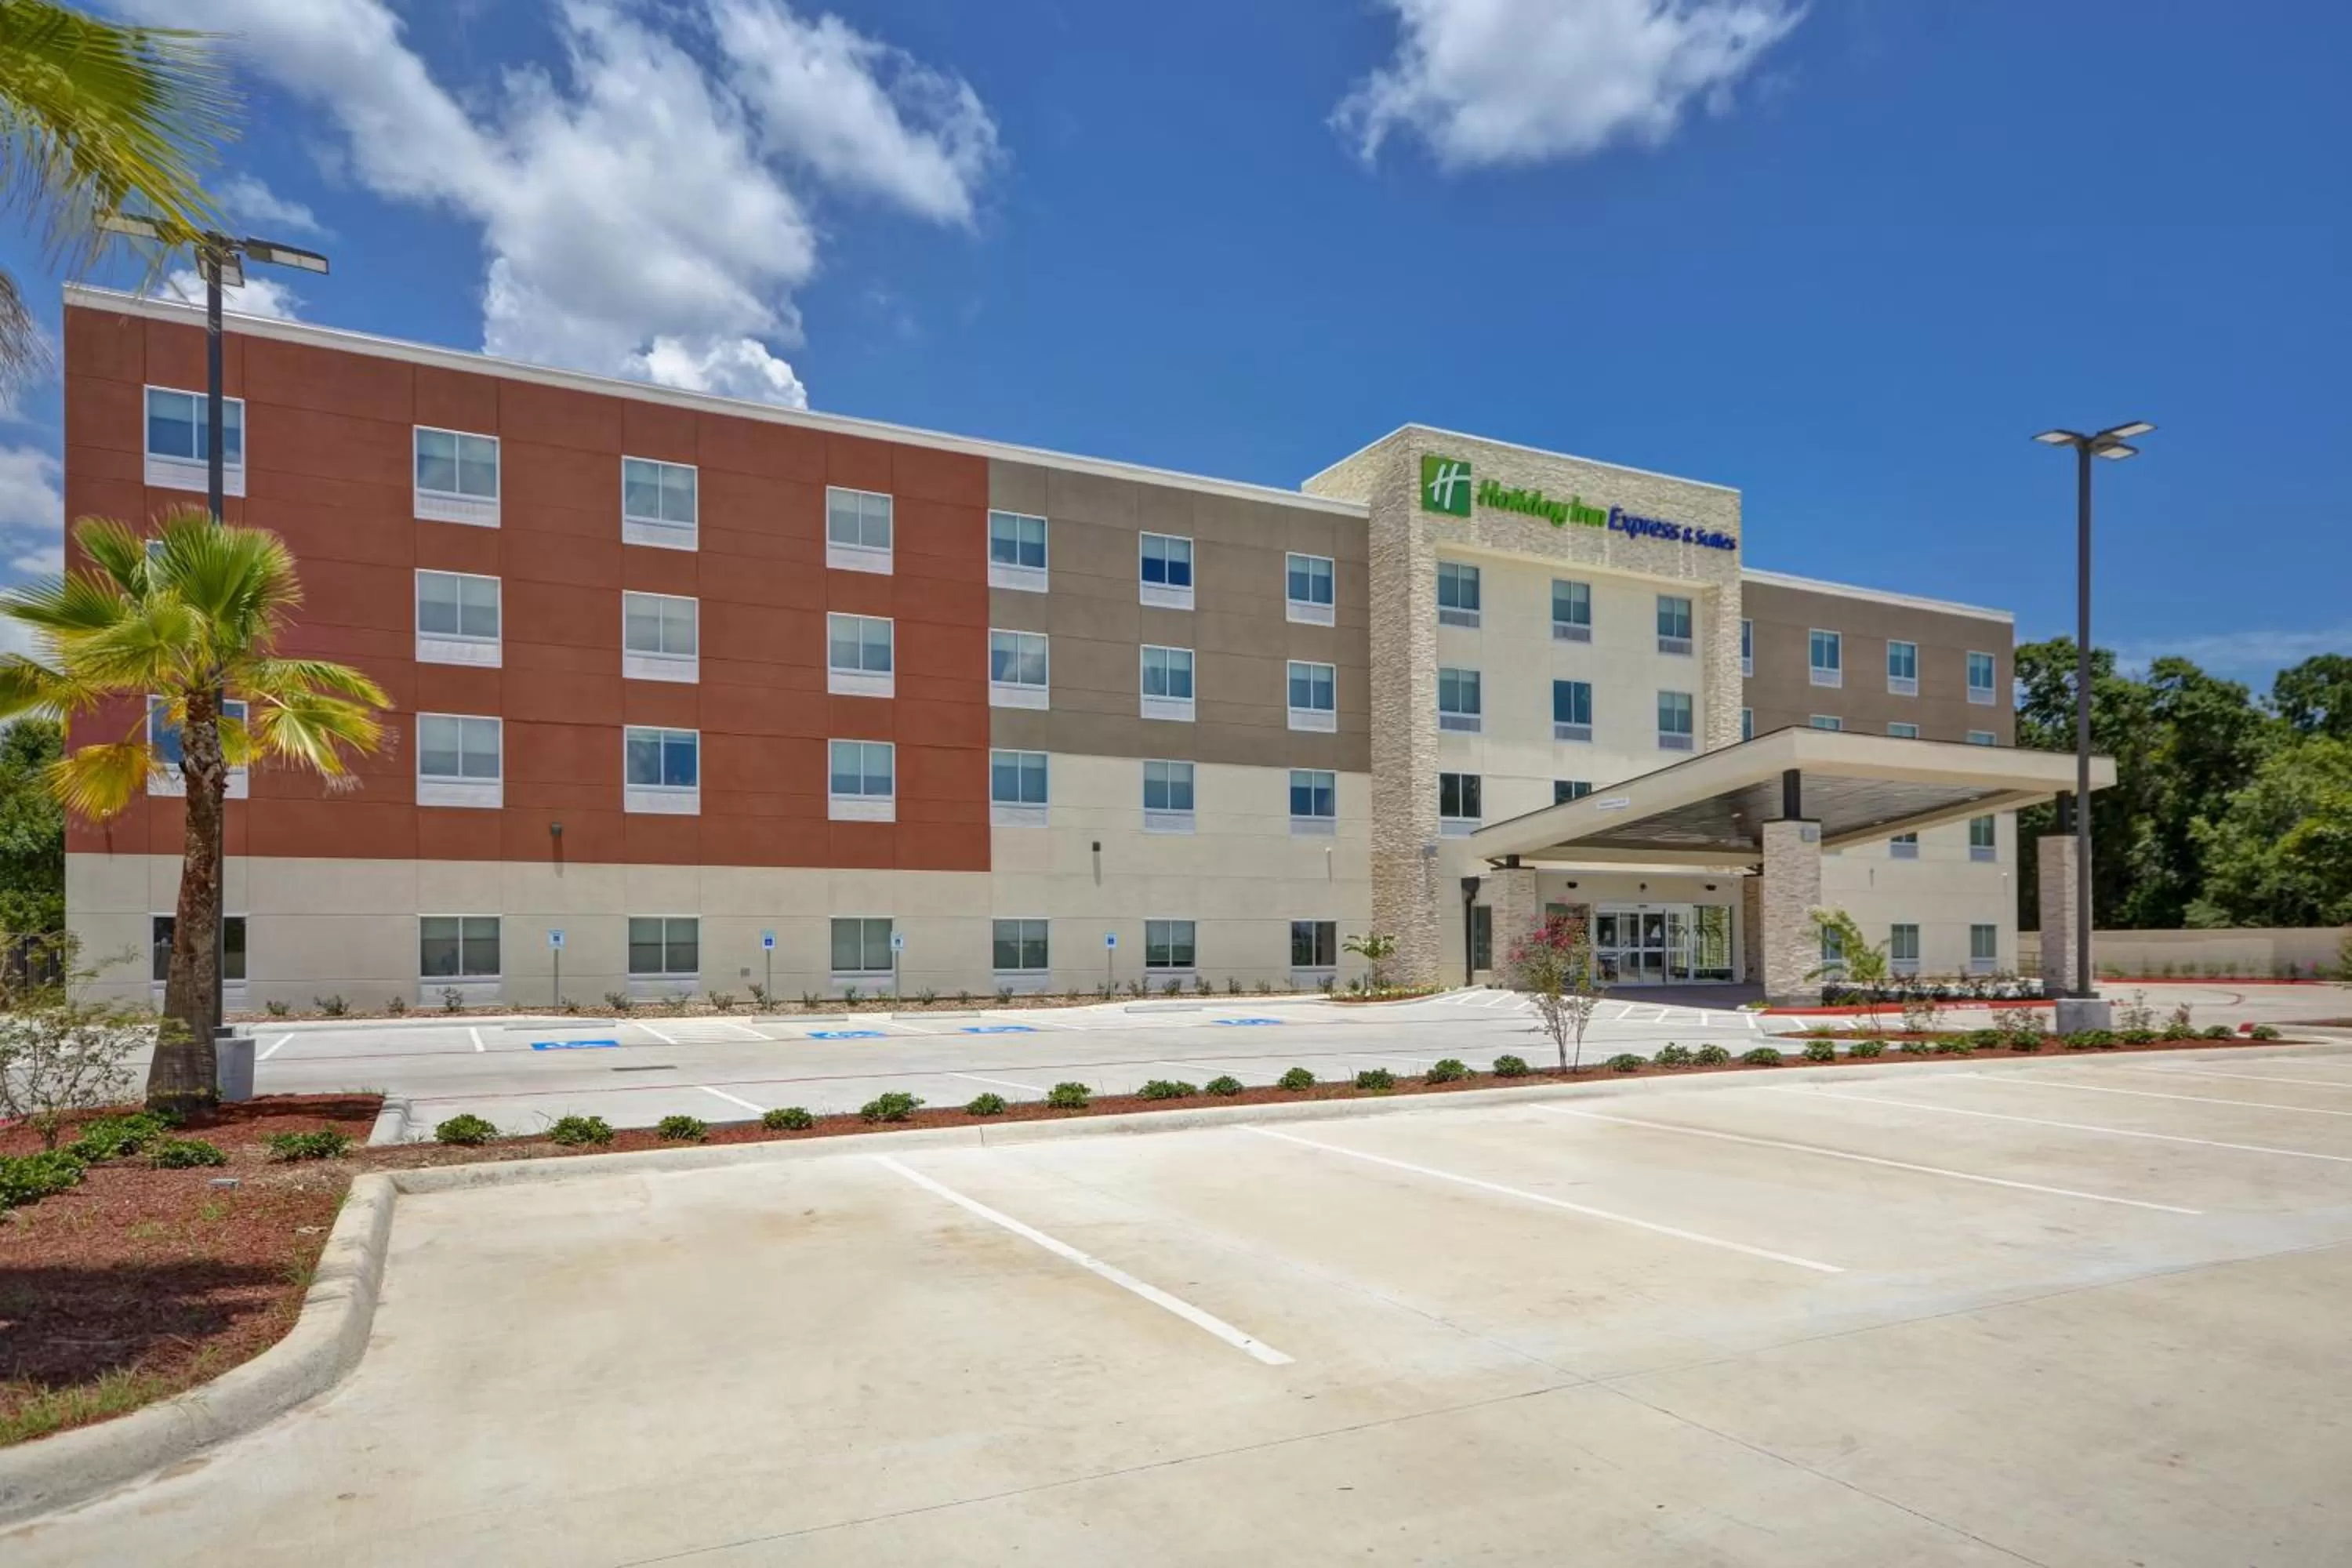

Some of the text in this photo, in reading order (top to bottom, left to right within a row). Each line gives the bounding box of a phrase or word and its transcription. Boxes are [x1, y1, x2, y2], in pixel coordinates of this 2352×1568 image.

[1478, 479, 1736, 550] Holiday Inn Express & Suites
